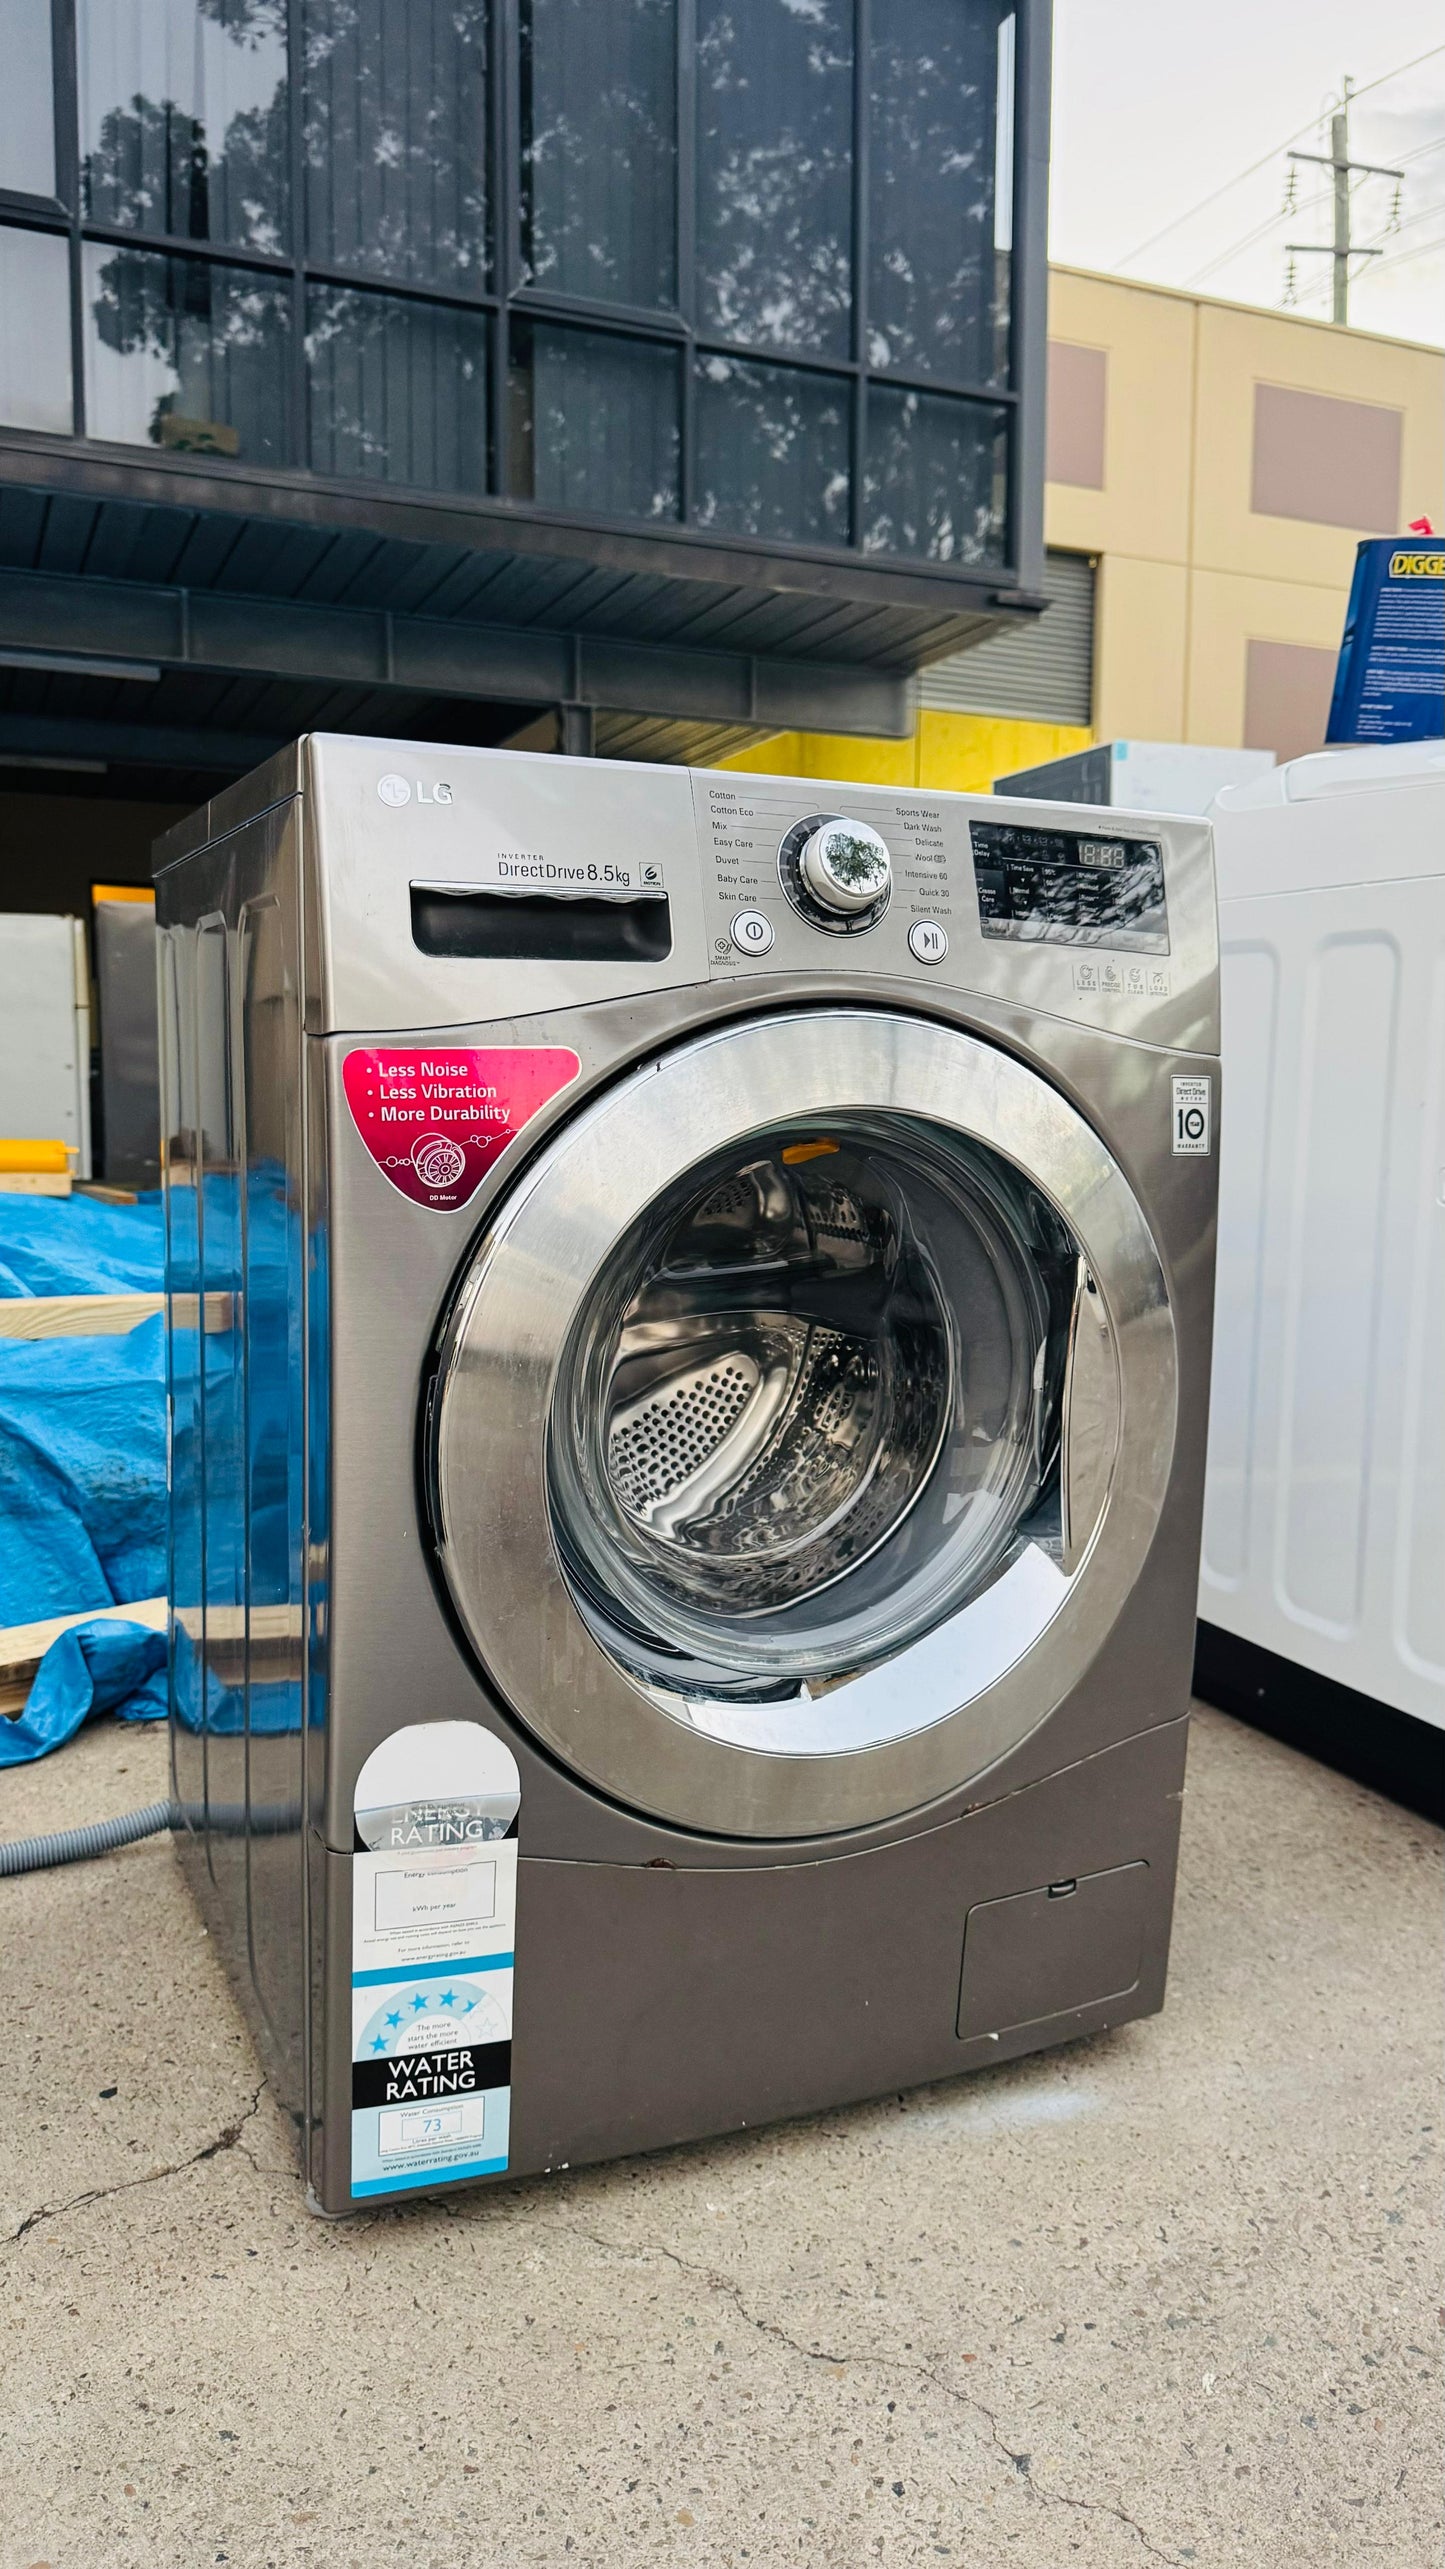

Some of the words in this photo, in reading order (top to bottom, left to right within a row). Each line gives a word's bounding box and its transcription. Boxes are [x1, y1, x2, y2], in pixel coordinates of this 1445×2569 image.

[417, 780, 453, 805] LG
[709, 790, 736, 800] Cotton
[710, 805, 737, 815] Cotton
[739, 808, 754, 816] Eco
[896, 808, 920, 817] Sports
[921, 810, 940, 819] Wear
[712, 822, 727, 830] Mix
[904, 822, 920, 830] Dark
[921, 824, 942, 832] Wash
[714, 837, 733, 847] Easy
[734, 839, 753, 848] Care
[915, 837, 944, 847] Delicate
[973, 841, 988, 849] Time
[497, 853, 544, 861] INVERTER
[915, 853, 932, 862] Wool
[973, 849, 990, 858] Delay
[715, 855, 739, 865] Duvet
[717, 874, 738, 885] Baby
[739, 875, 758, 884] Care
[905, 870, 938, 879] Intensive
[718, 892, 736, 901] Skin
[738, 893, 757, 902] Care
[919, 888, 939, 896] Quick
[910, 904, 930, 914] Silent
[932, 906, 952, 915] Wash
[378, 1062, 416, 1077] Less
[421, 1062, 468, 1077] Noise
[380, 1084, 416, 1100] Less
[421, 1084, 497, 1099] Vibration
[1176, 1087, 1192, 1095] Direct
[1192, 1088, 1206, 1096] Drive
[381, 1106, 425, 1122] More
[430, 1105, 510, 1124] Durability
[1177, 1108, 1204, 1139] 10
[391, 1820, 482, 1845] RATING
[404, 1871, 425, 1879] Energy
[426, 2032, 437, 2040] the
[431, 2038, 457, 2047] efficient
[388, 2050, 474, 2079] WATER
[386, 2071, 476, 2100] RATING
[400, 2109, 420, 2118] Water
[424, 2118, 441, 2133] 73
[383, 2151, 479, 2171] www.waterrating.gov.au
